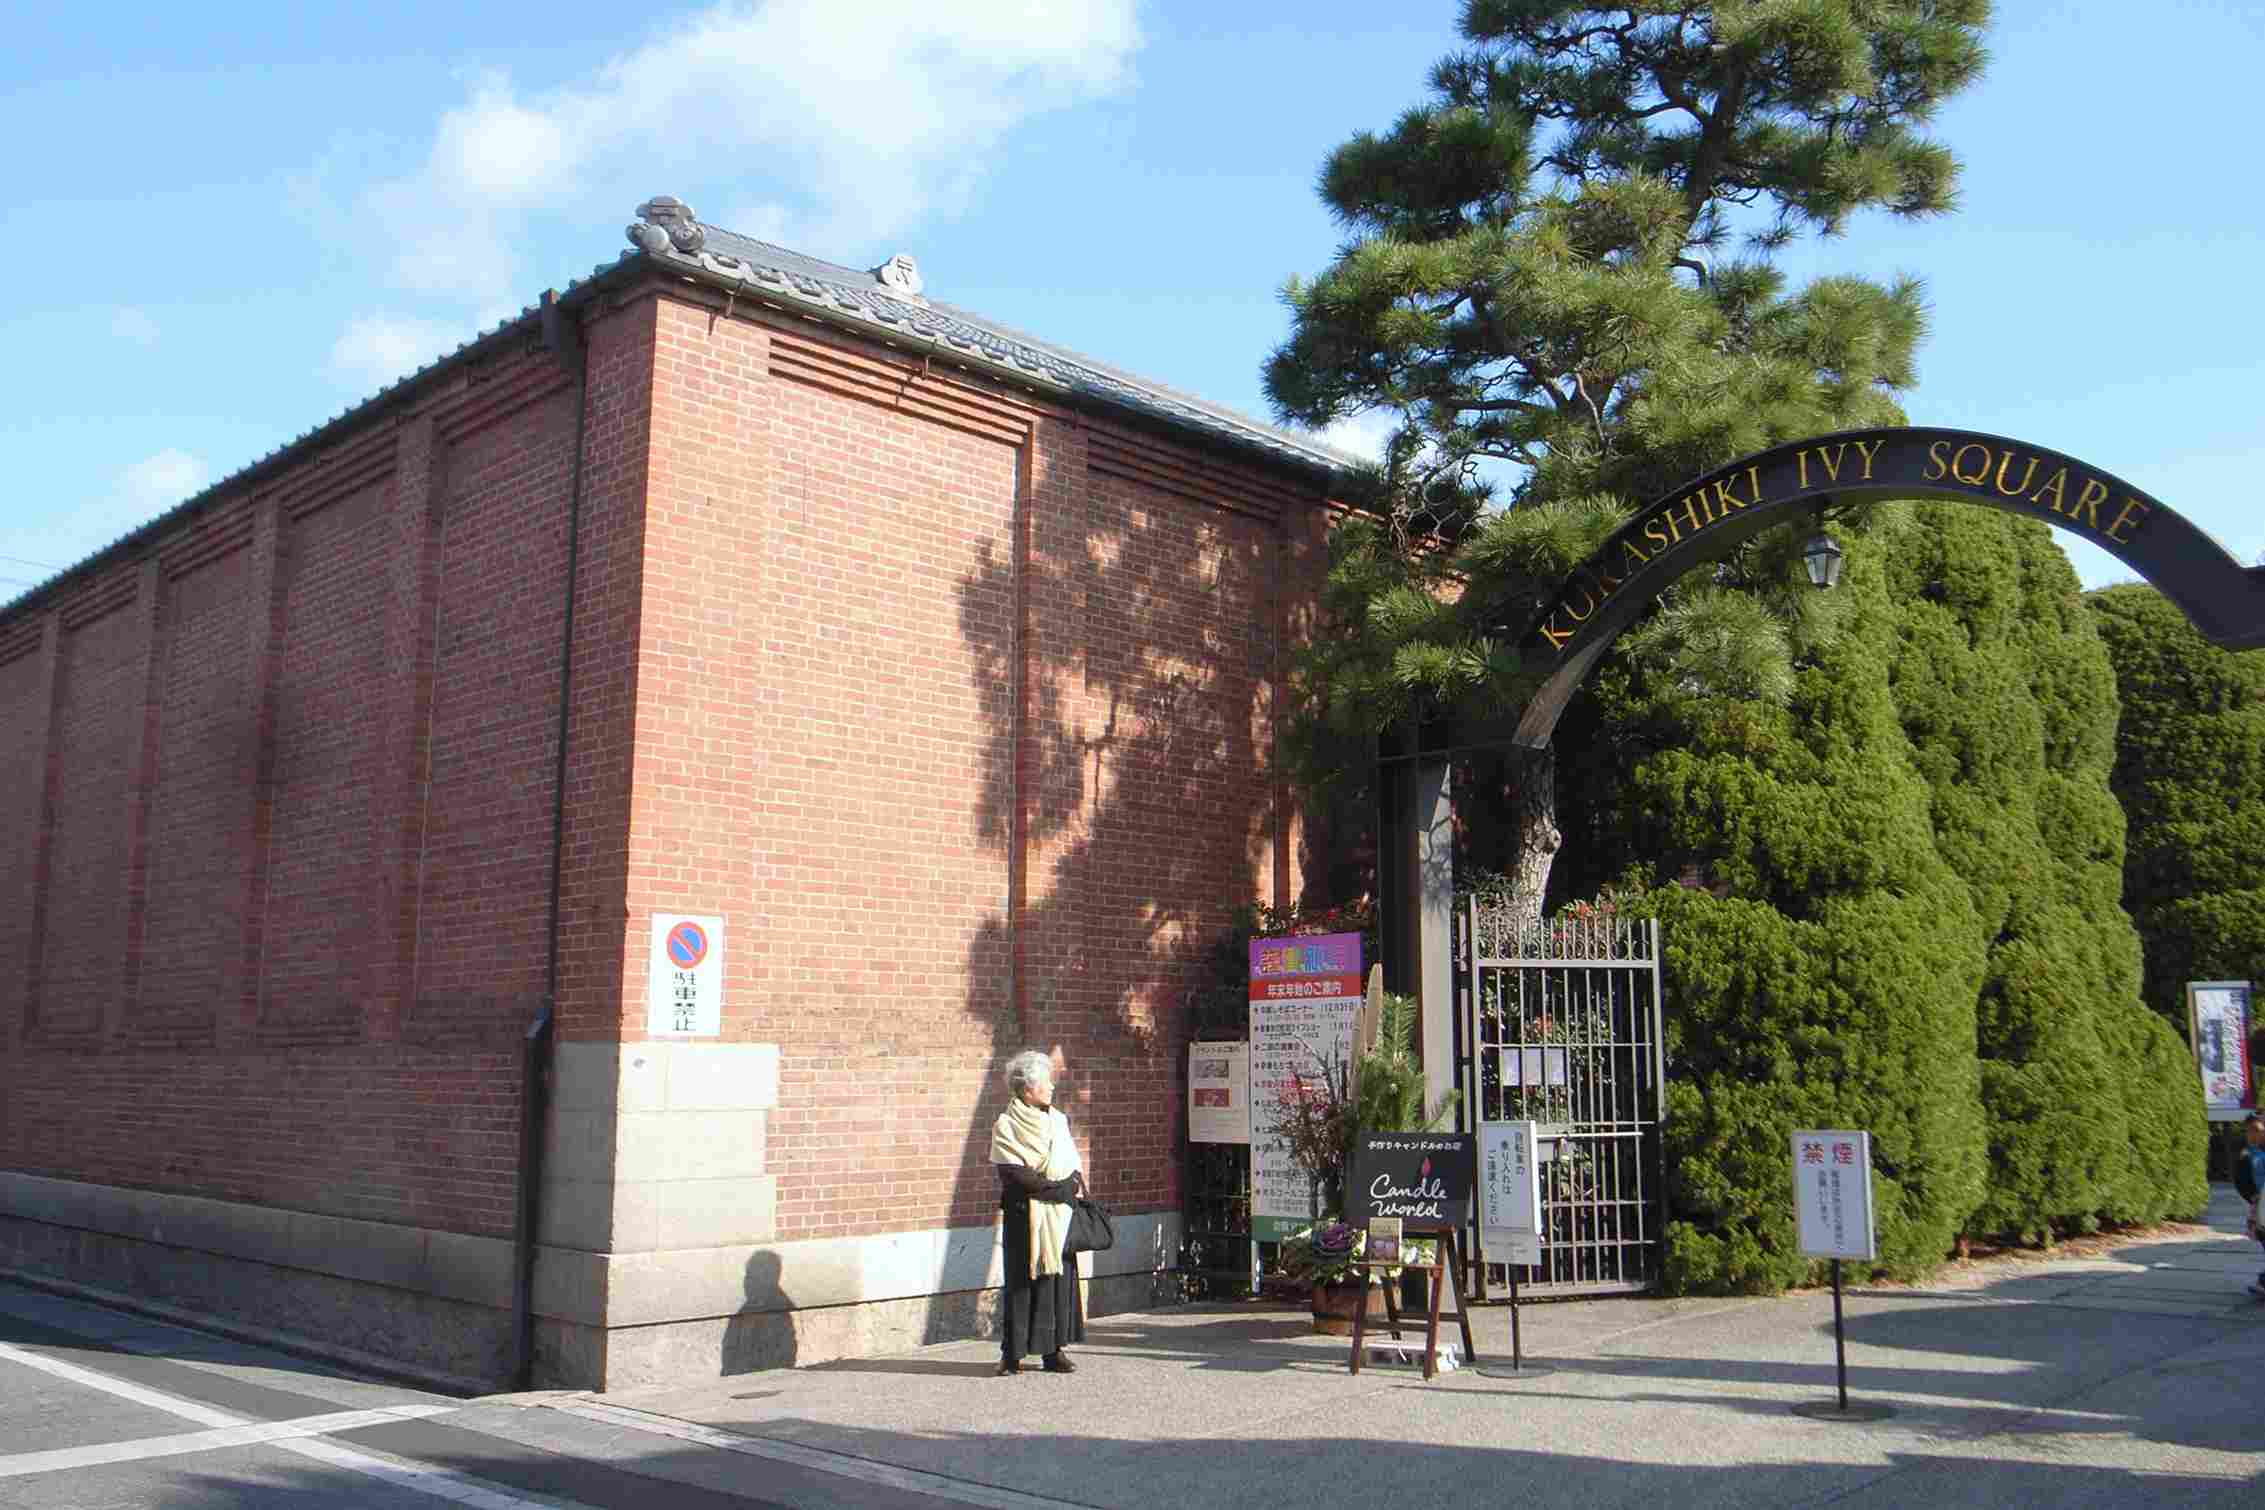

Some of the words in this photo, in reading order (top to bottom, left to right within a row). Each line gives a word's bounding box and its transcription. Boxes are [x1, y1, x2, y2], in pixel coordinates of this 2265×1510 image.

[1540, 466, 1764, 652] KURASHIKI
[1796, 439, 1886, 489] IVY
[1922, 440, 2152, 545] SQUARE
[671, 970, 697, 1033] 駐車禁止
[1367, 1140, 1464, 1151] 手作りキャンドルのお店
[1800, 1142, 1856, 1165] 禁煙
[1369, 1173, 1449, 1200] Candle
[1487, 1149, 1499, 1226] ご遠慮ください
[1501, 1140, 1513, 1195] 乗り入れは
[1369, 1200, 1444, 1219] World
